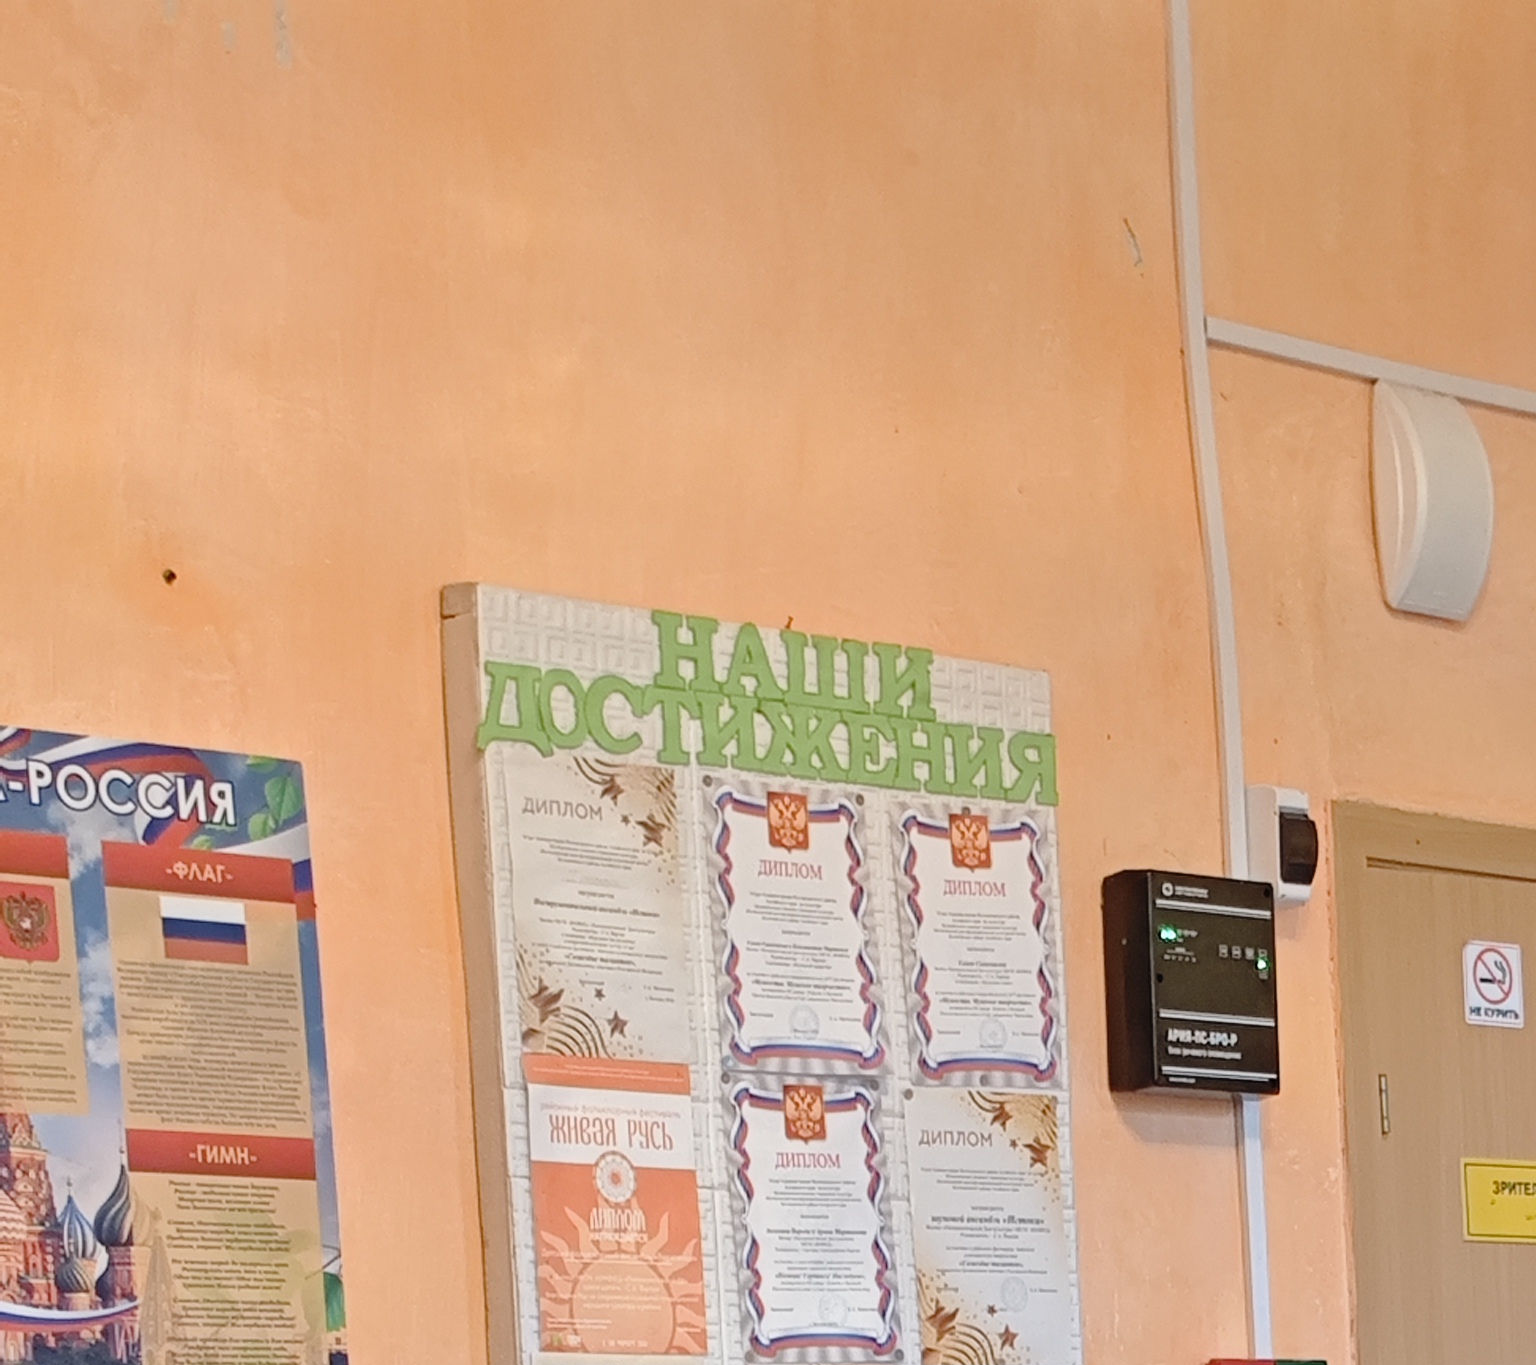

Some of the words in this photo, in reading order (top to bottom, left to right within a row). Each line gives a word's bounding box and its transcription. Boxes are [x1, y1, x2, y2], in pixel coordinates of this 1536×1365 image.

[652, 609, 937, 722] НАШИ
[477, 660, 1060, 807] ДОСТИЖЕНИЯ
[0, 759, 238, 826] -РОССИЯ
[522, 797, 603, 822] ДИПЛОМ
[757, 860, 824, 880] ДИПЛОМ
[943, 879, 1007, 898] ДИПЛОМ
[1469, 1006, 1482, 1017] НЕ
[1484, 1007, 1519, 1020] КУРИТЬ
[627, 1119, 674, 1150] РУСЬ
[918, 1129, 993, 1148] ДИПЛОМ
[775, 1152, 842, 1170] ДИПЛОМ
